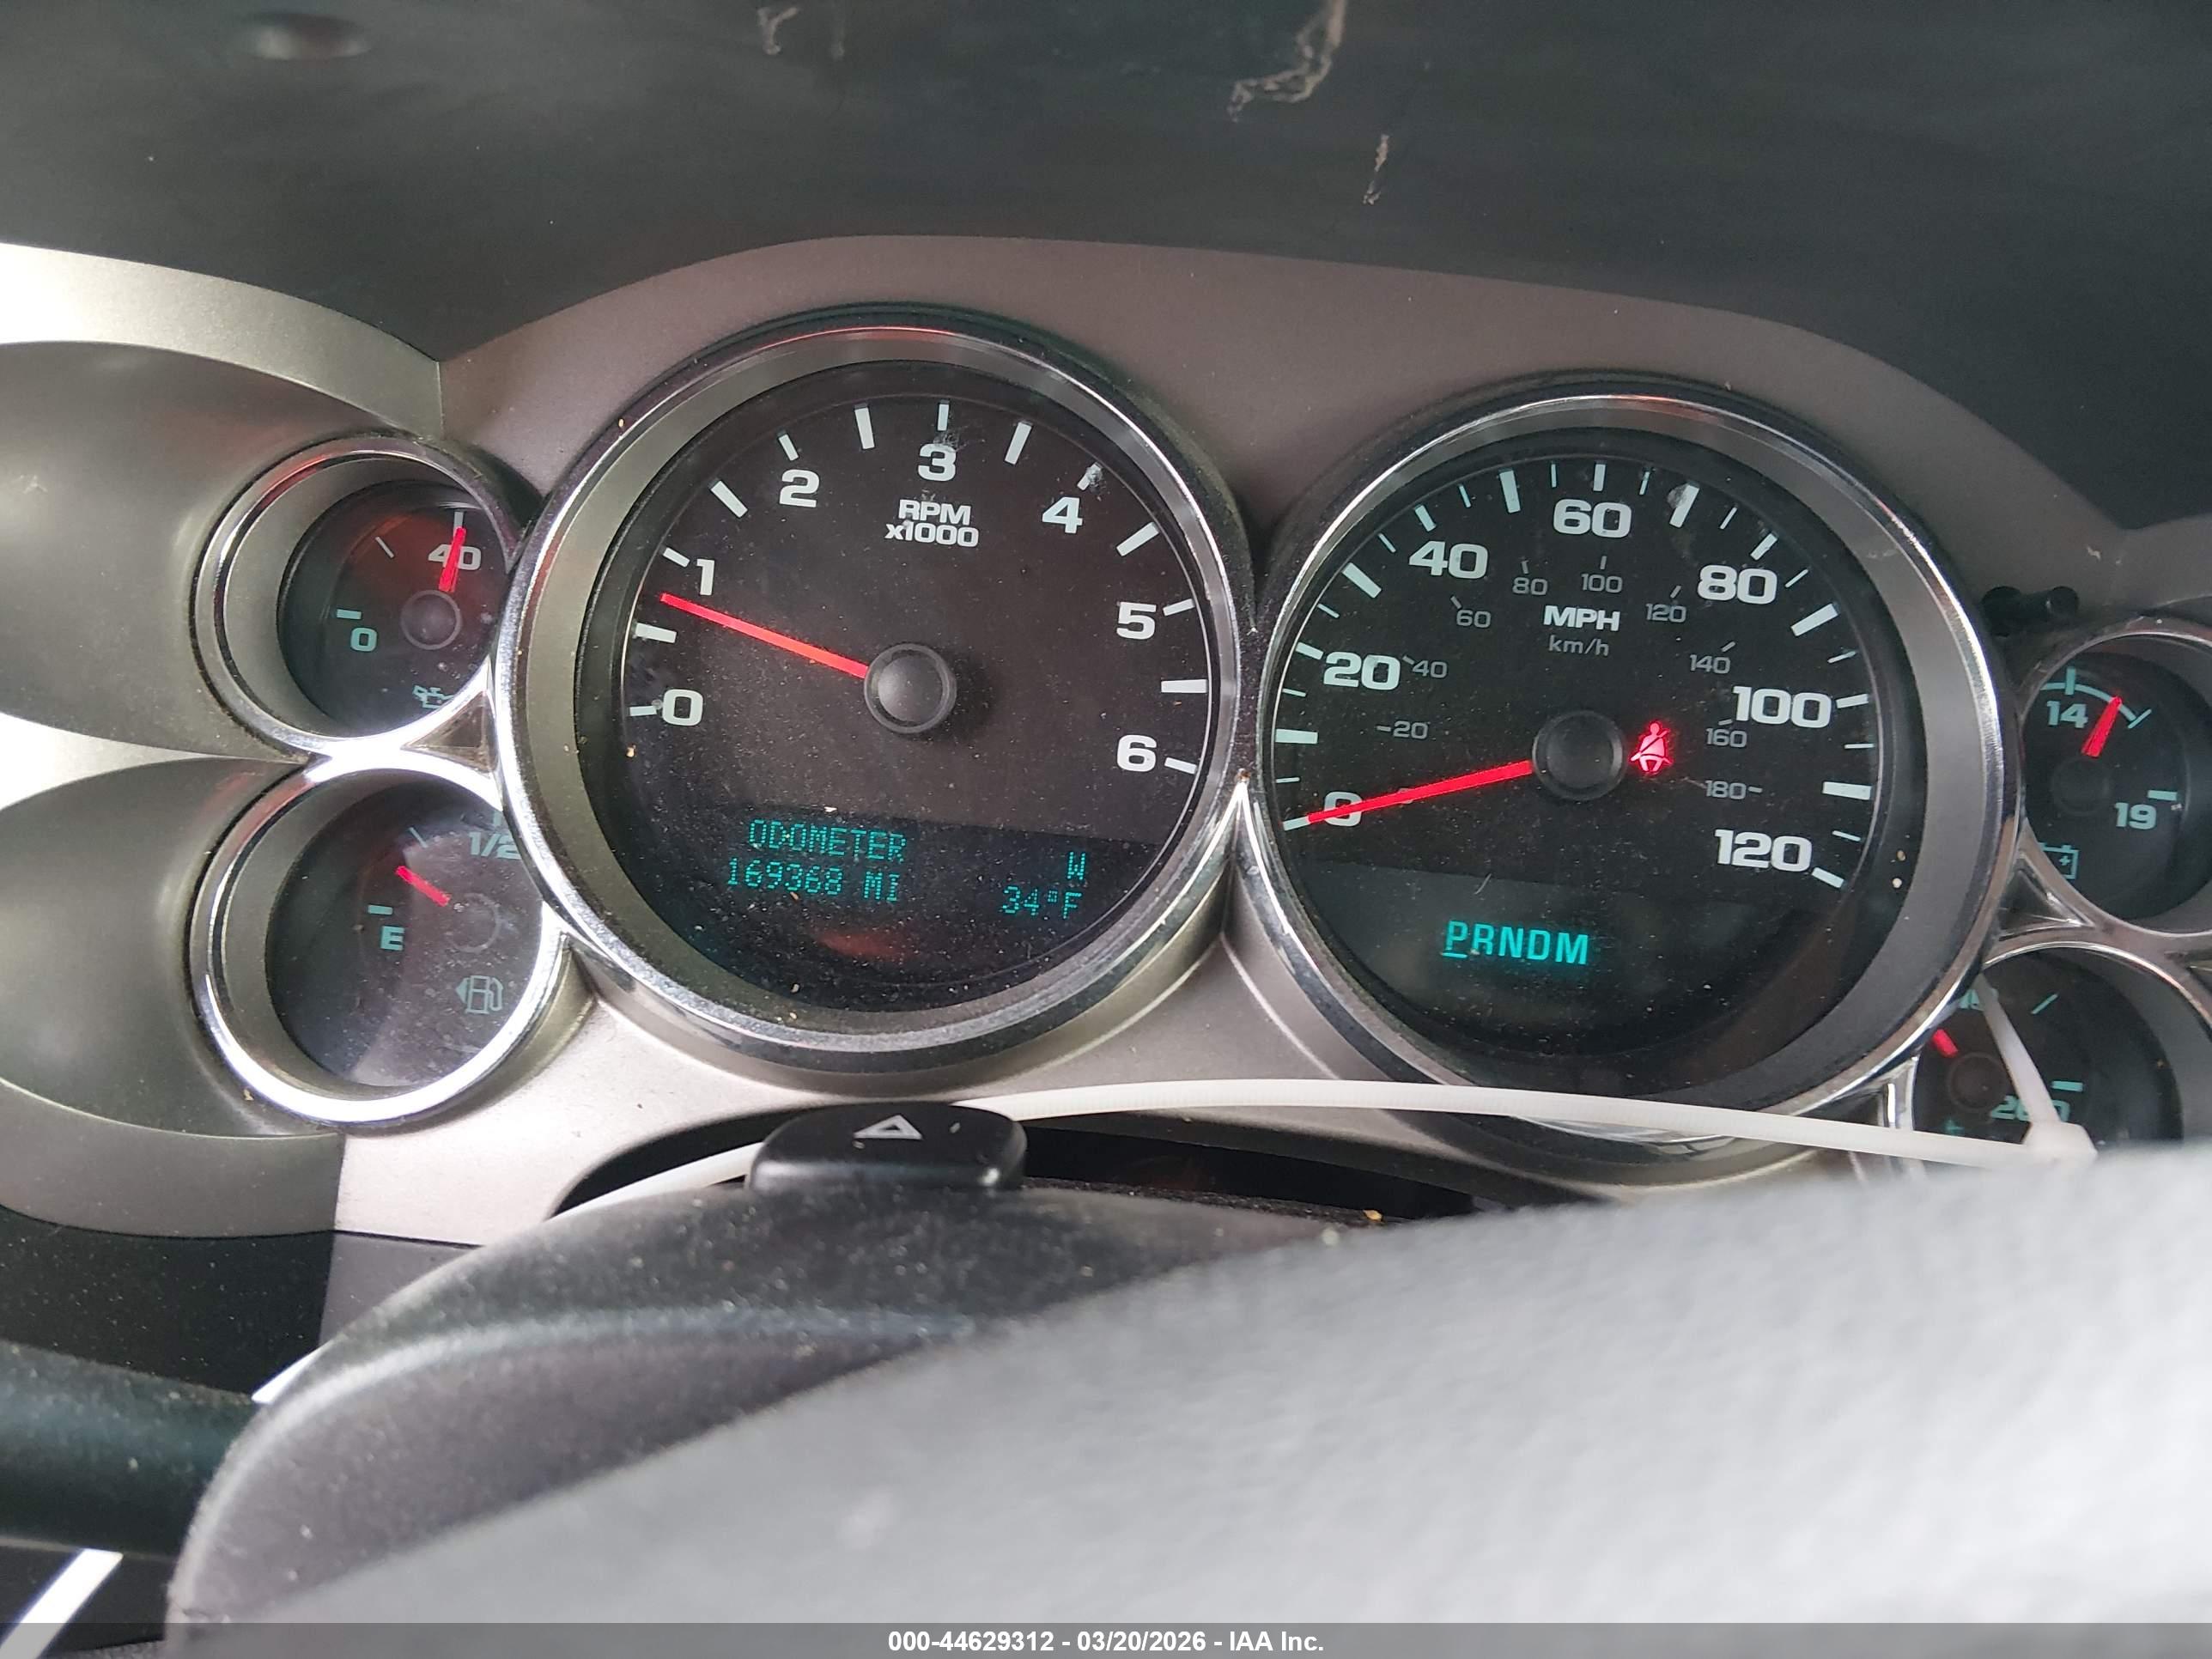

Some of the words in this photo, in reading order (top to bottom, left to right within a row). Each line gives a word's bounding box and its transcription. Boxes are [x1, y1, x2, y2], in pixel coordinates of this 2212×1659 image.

[918, 443, 957, 482] 3
[779, 470, 820, 507] 2
[898, 499, 971, 526] RPM
[1042, 496, 1083, 533] 4
[1553, 499, 1632, 539] 60
[884, 519, 979, 547] x1000
[428, 544, 482, 571] 40
[1409, 541, 1488, 580] 40
[696, 559, 715, 595] 1
[1512, 576, 1548, 596] 80
[1581, 573, 1623, 593] 100
[1697, 564, 1778, 605] 80
[1118, 602, 1157, 640] 5
[1456, 610, 1492, 629] 60
[1543, 605, 1620, 632] MPH
[1645, 603, 1687, 623] 120
[350, 627, 378, 653] 0
[1548, 634, 1610, 657] km/h
[1322, 651, 1401, 690] 20
[1413, 659, 1448, 678] 40
[1689, 654, 1730, 675] 140
[662, 689, 704, 727] 0
[1733, 685, 1832, 728] 100
[2047, 701, 2087, 729] 14
[1393, 720, 1429, 740] 20
[1706, 727, 1747, 749] 160
[1118, 736, 1157, 773] 6
[1705, 780, 1747, 800] 180
[1324, 791, 1363, 827] 0
[2114, 802, 2157, 830] 19
[469, 831, 523, 860] 1/2
[748, 818, 908, 864] ODOMETER
[1715, 829, 1814, 873] 120
[727, 857, 843, 896] 169368
[864, 870, 901, 902] MI
[1066, 851, 1086, 881] W
[380, 926, 405, 951] E
[1444, 920, 1590, 966] PRNDM
